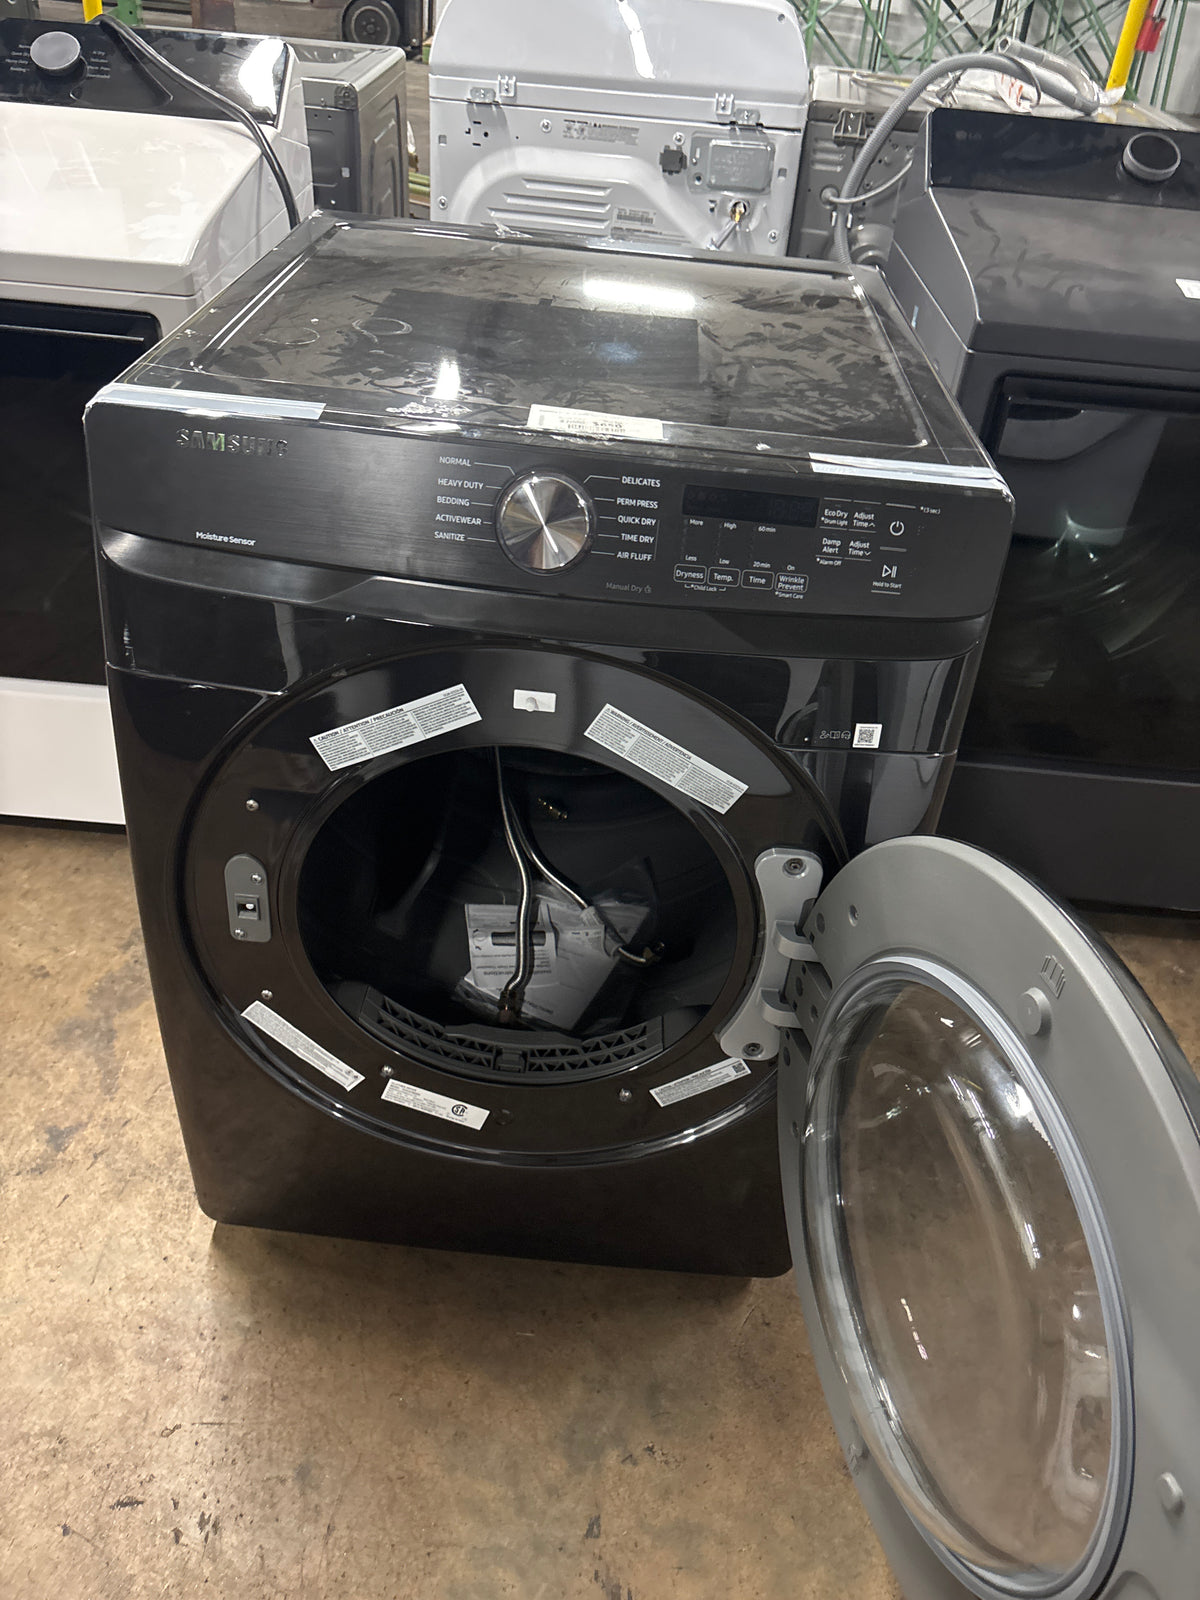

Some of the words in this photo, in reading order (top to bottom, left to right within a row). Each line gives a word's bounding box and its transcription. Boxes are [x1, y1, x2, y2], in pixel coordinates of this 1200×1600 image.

[176, 428, 288, 456] SAMSUNG
[440, 456, 472, 466] NORMAL
[438, 478, 462, 487] HEAVY
[464, 480, 484, 489] DUTY
[622, 476, 660, 488] DELICATES
[436, 496, 470, 506] BEDDING
[616, 498, 636, 507] PERM
[637, 499, 658, 509] PRESS
[824, 509, 836, 517] Eco
[837, 510, 848, 519] Dry
[854, 512, 874, 520] Adjust
[435, 514, 482, 525] ACTIVEWEAR
[618, 515, 640, 525] QUICK
[641, 518, 656, 526] DRY
[724, 522, 737, 530] High
[196, 531, 228, 542] Moisture
[229, 536, 256, 546] Sensor
[434, 531, 465, 541] SANITIZE
[621, 533, 638, 542] TIME
[639, 535, 654, 544] DRY
[822, 538, 841, 546] Damp
[849, 540, 870, 549] Adjust
[617, 552, 629, 560] AIR
[630, 553, 652, 562] FLUFF
[676, 570, 704, 579] Dryness
[714, 573, 734, 582] Temp.
[779, 575, 805, 584] Wrinkle
[749, 576, 766, 584] Time
[606, 582, 629, 591] Manual
[631, 584, 642, 593] Dry
[777, 582, 804, 591] Prevent
[611, 710, 630, 723] WARNING
[318, 731, 340, 741] CAUTION
[343, 720, 370, 732] ATTENTION
[374, 708, 404, 722] PRECAUCIÓN
